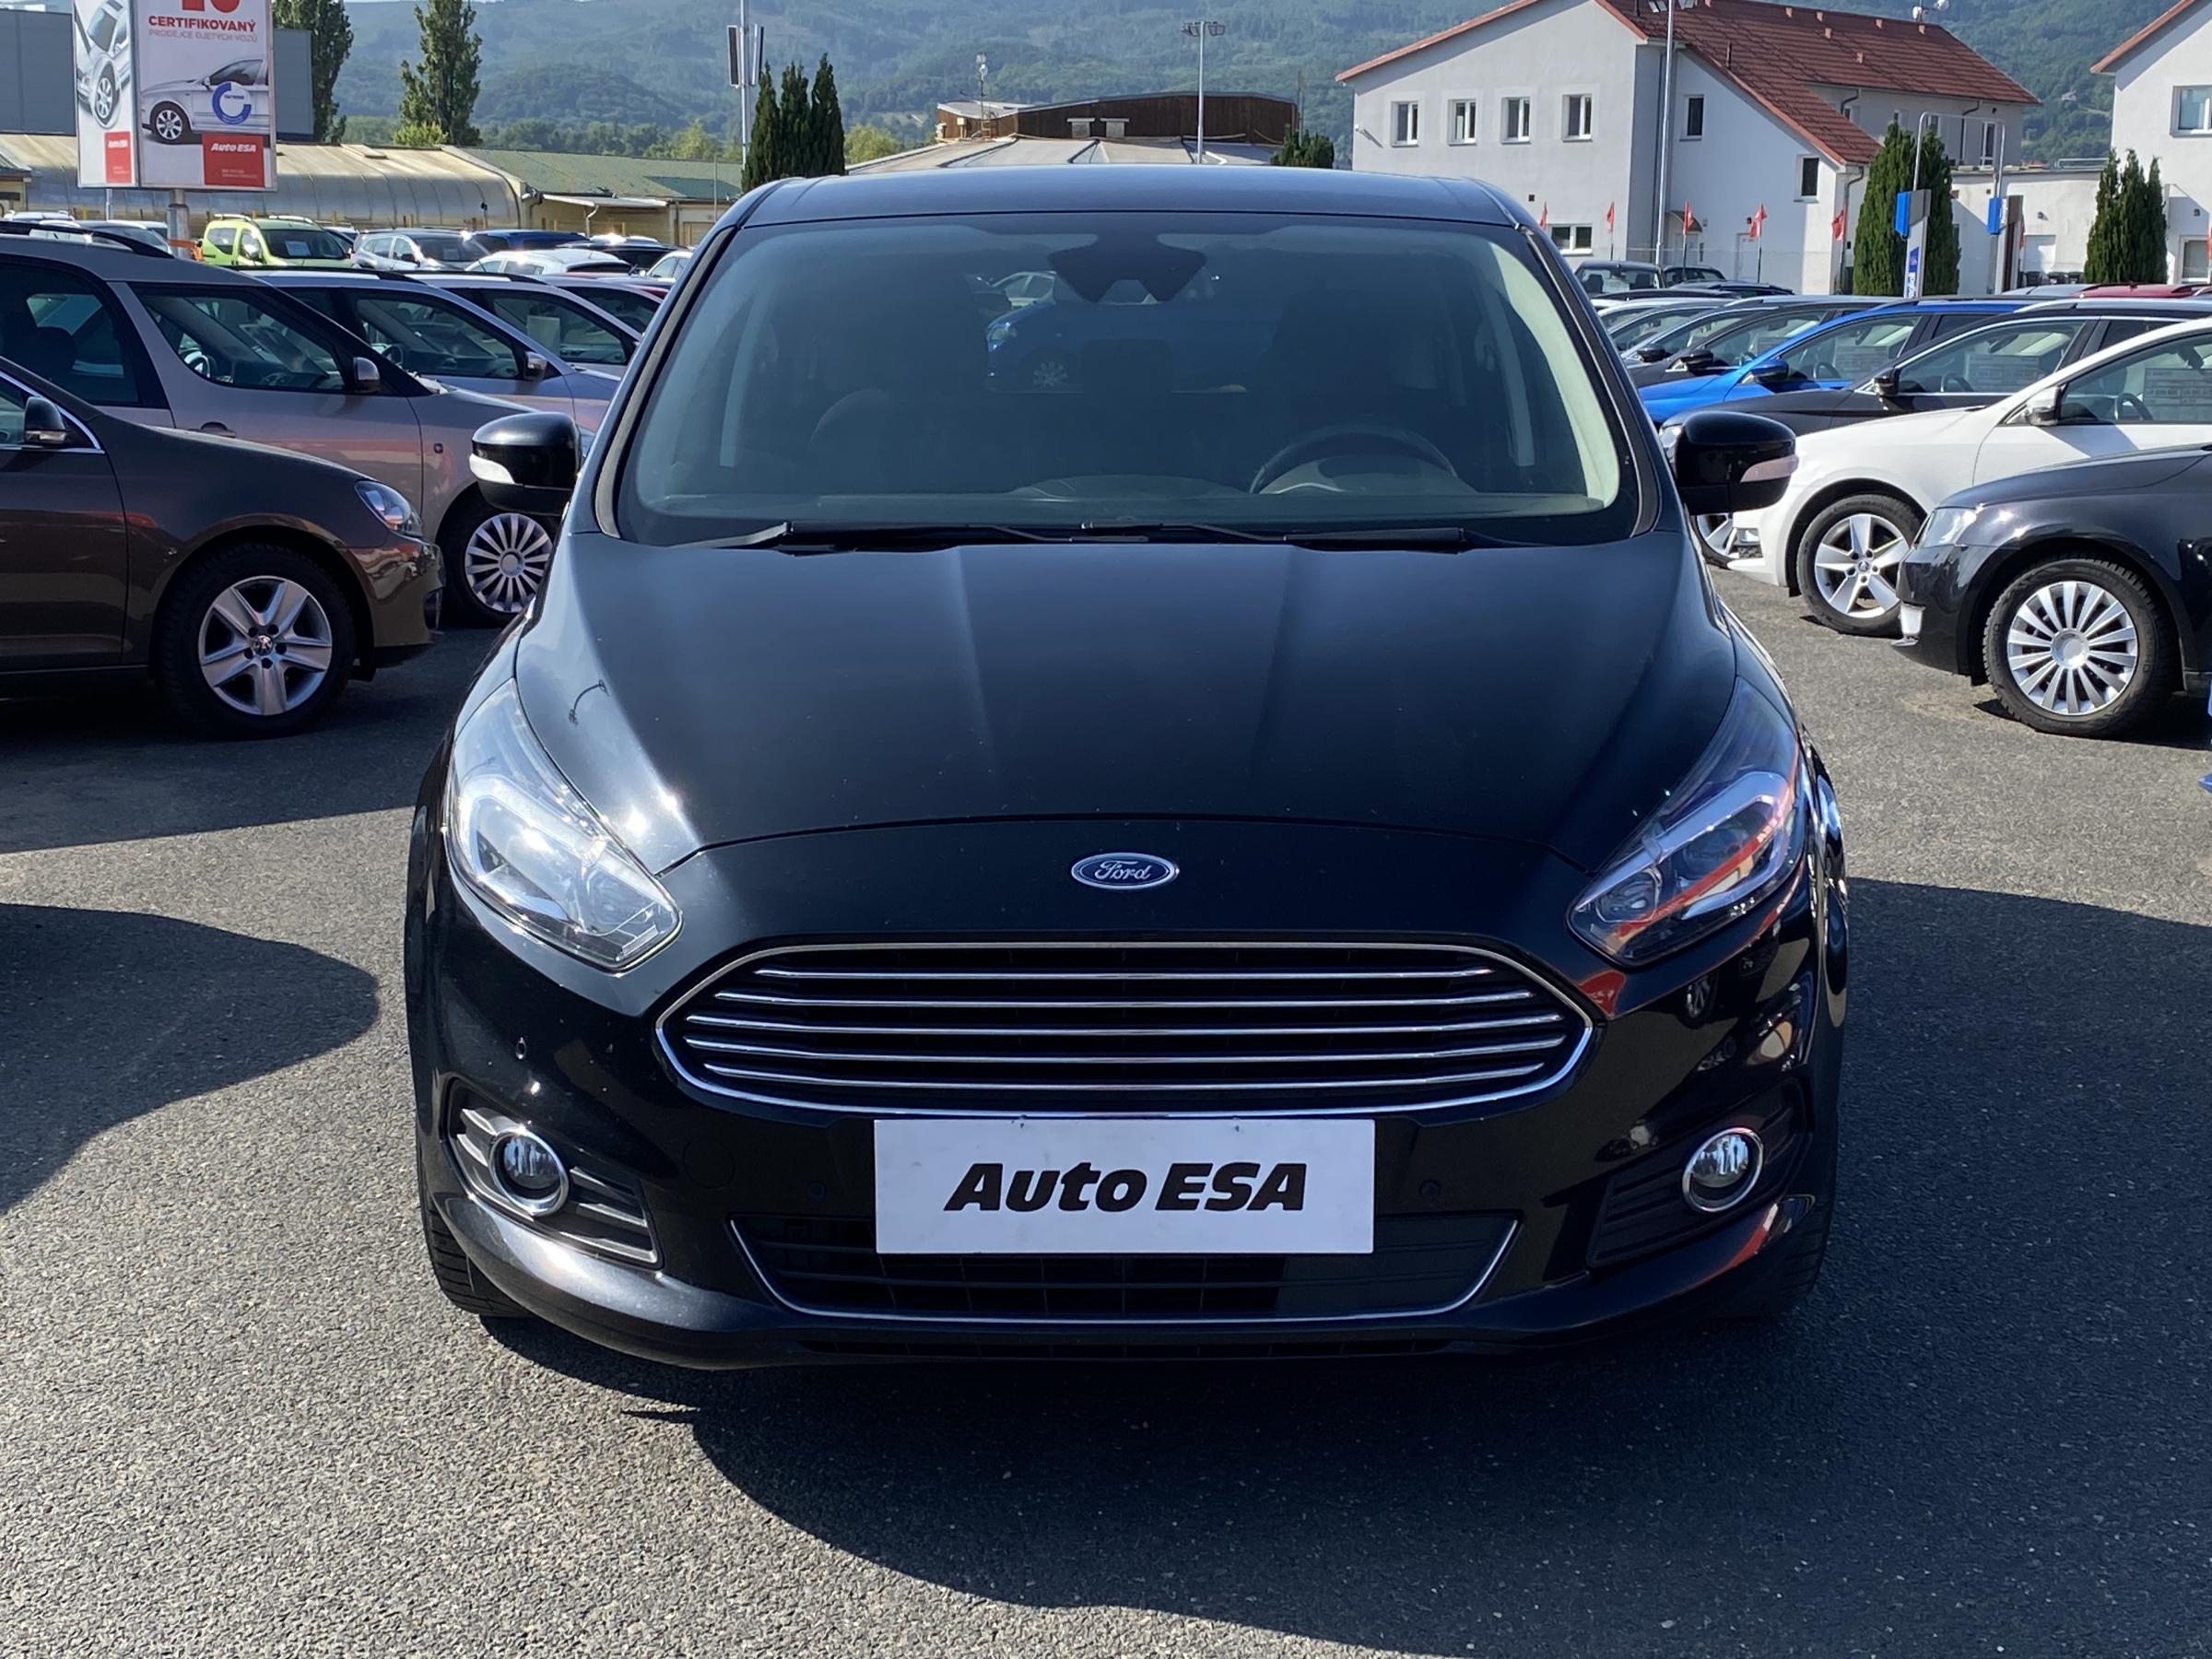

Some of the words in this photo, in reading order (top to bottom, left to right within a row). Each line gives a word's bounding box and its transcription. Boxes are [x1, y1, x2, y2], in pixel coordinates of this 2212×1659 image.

[147, 15, 256, 32] CERTIFIKOVANÝ
[210, 142, 236, 152] Auto
[237, 143, 257, 153] ESA
[1094, 860, 1152, 880] Ford
[943, 1161, 1147, 1212] Auto
[1155, 1162, 1307, 1212] ESA
